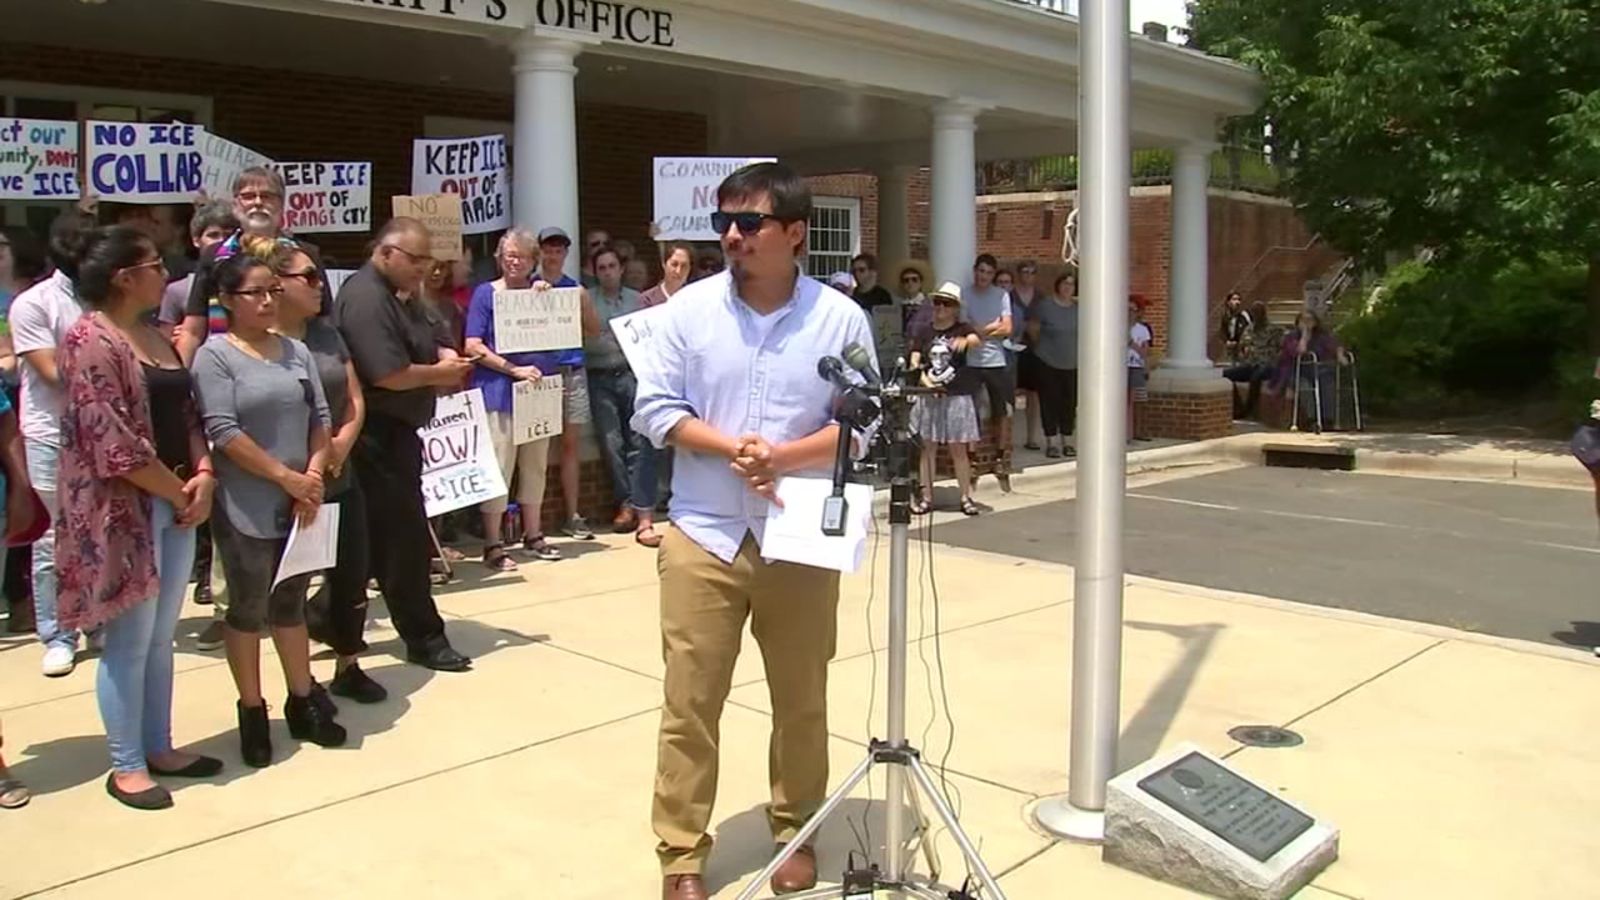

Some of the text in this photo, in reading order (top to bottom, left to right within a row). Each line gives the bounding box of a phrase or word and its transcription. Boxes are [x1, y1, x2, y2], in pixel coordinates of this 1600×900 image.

[536, 0, 674, 47] OFFICE
[30, 127, 66, 145] our
[94, 124, 195, 146] NO ICE
[0, 145, 44, 174] unity,
[425, 138, 506, 175] KEEP ICE
[92, 152, 203, 194] COLLAB
[265, 163, 326, 186] EEP
[331, 164, 367, 187] ICE
[659, 161, 744, 178] COMUNI
[0, 172, 75, 195] ve ICE
[440, 172, 498, 199] OUT OF
[288, 189, 350, 211] OUT OF
[408, 196, 438, 215] NO
[461, 193, 504, 225] ANGE
[528, 421, 553, 439] ICE
[449, 473, 486, 499] ICE
